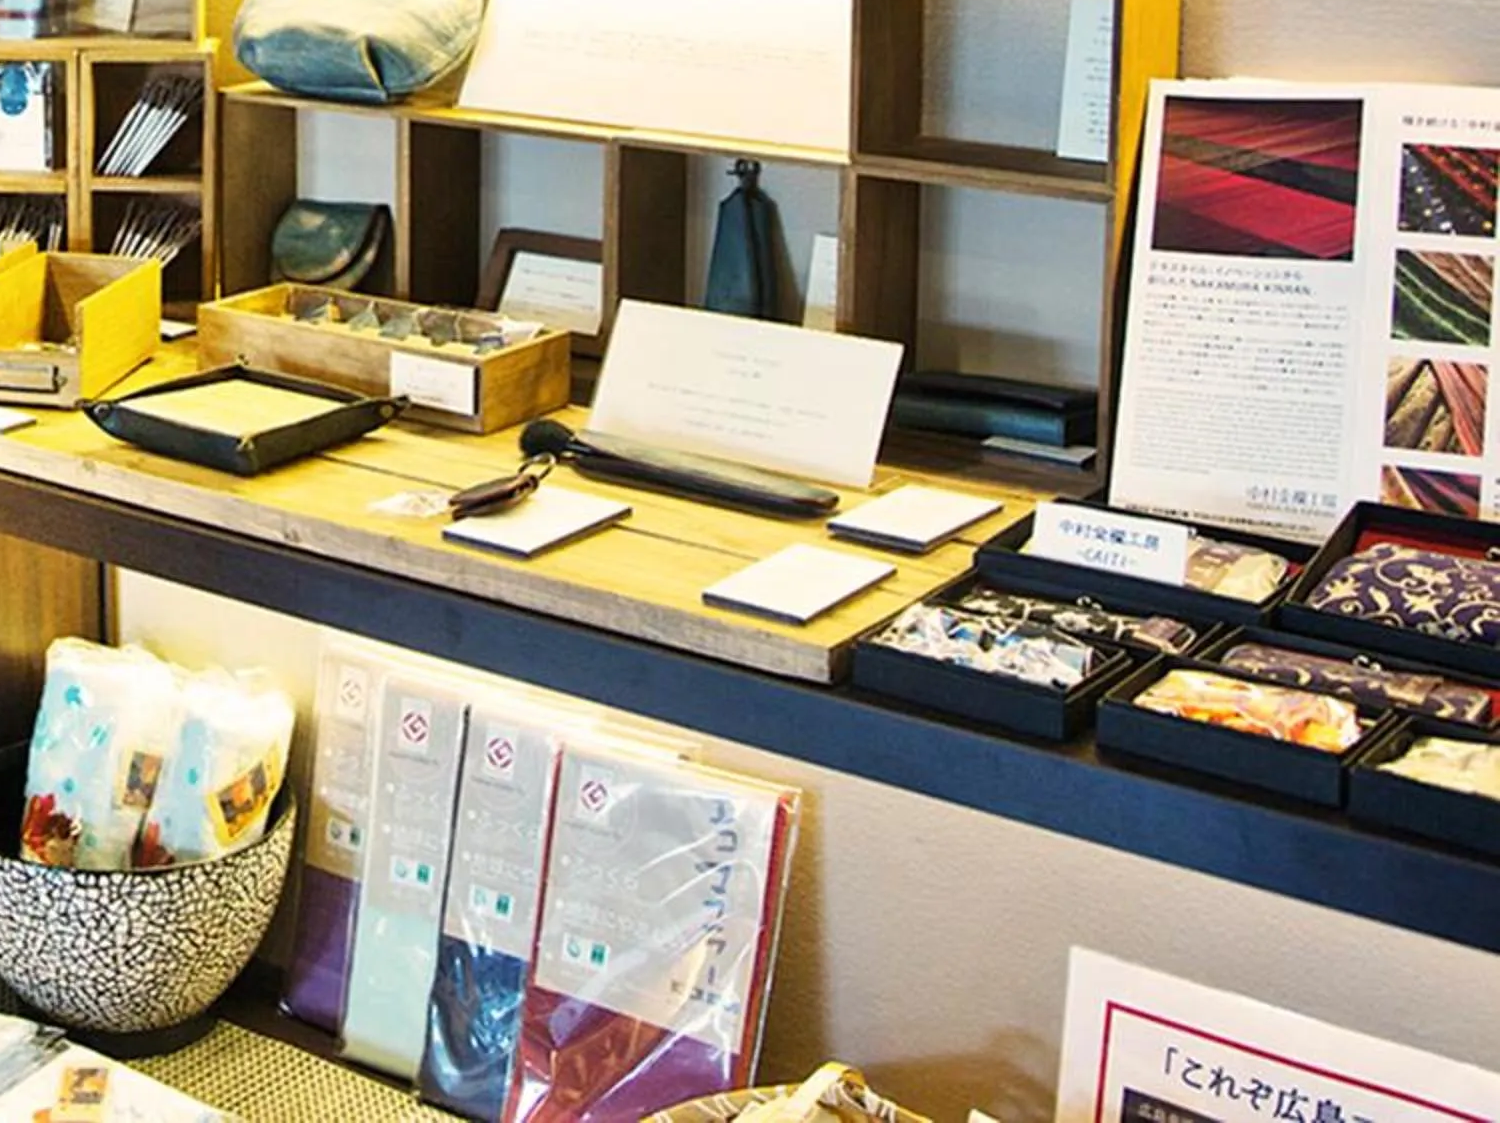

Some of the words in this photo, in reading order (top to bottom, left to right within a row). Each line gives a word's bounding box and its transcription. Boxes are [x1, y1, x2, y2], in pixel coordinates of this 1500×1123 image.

[1162, 1046, 1374, 1123] 「これぞ広島
